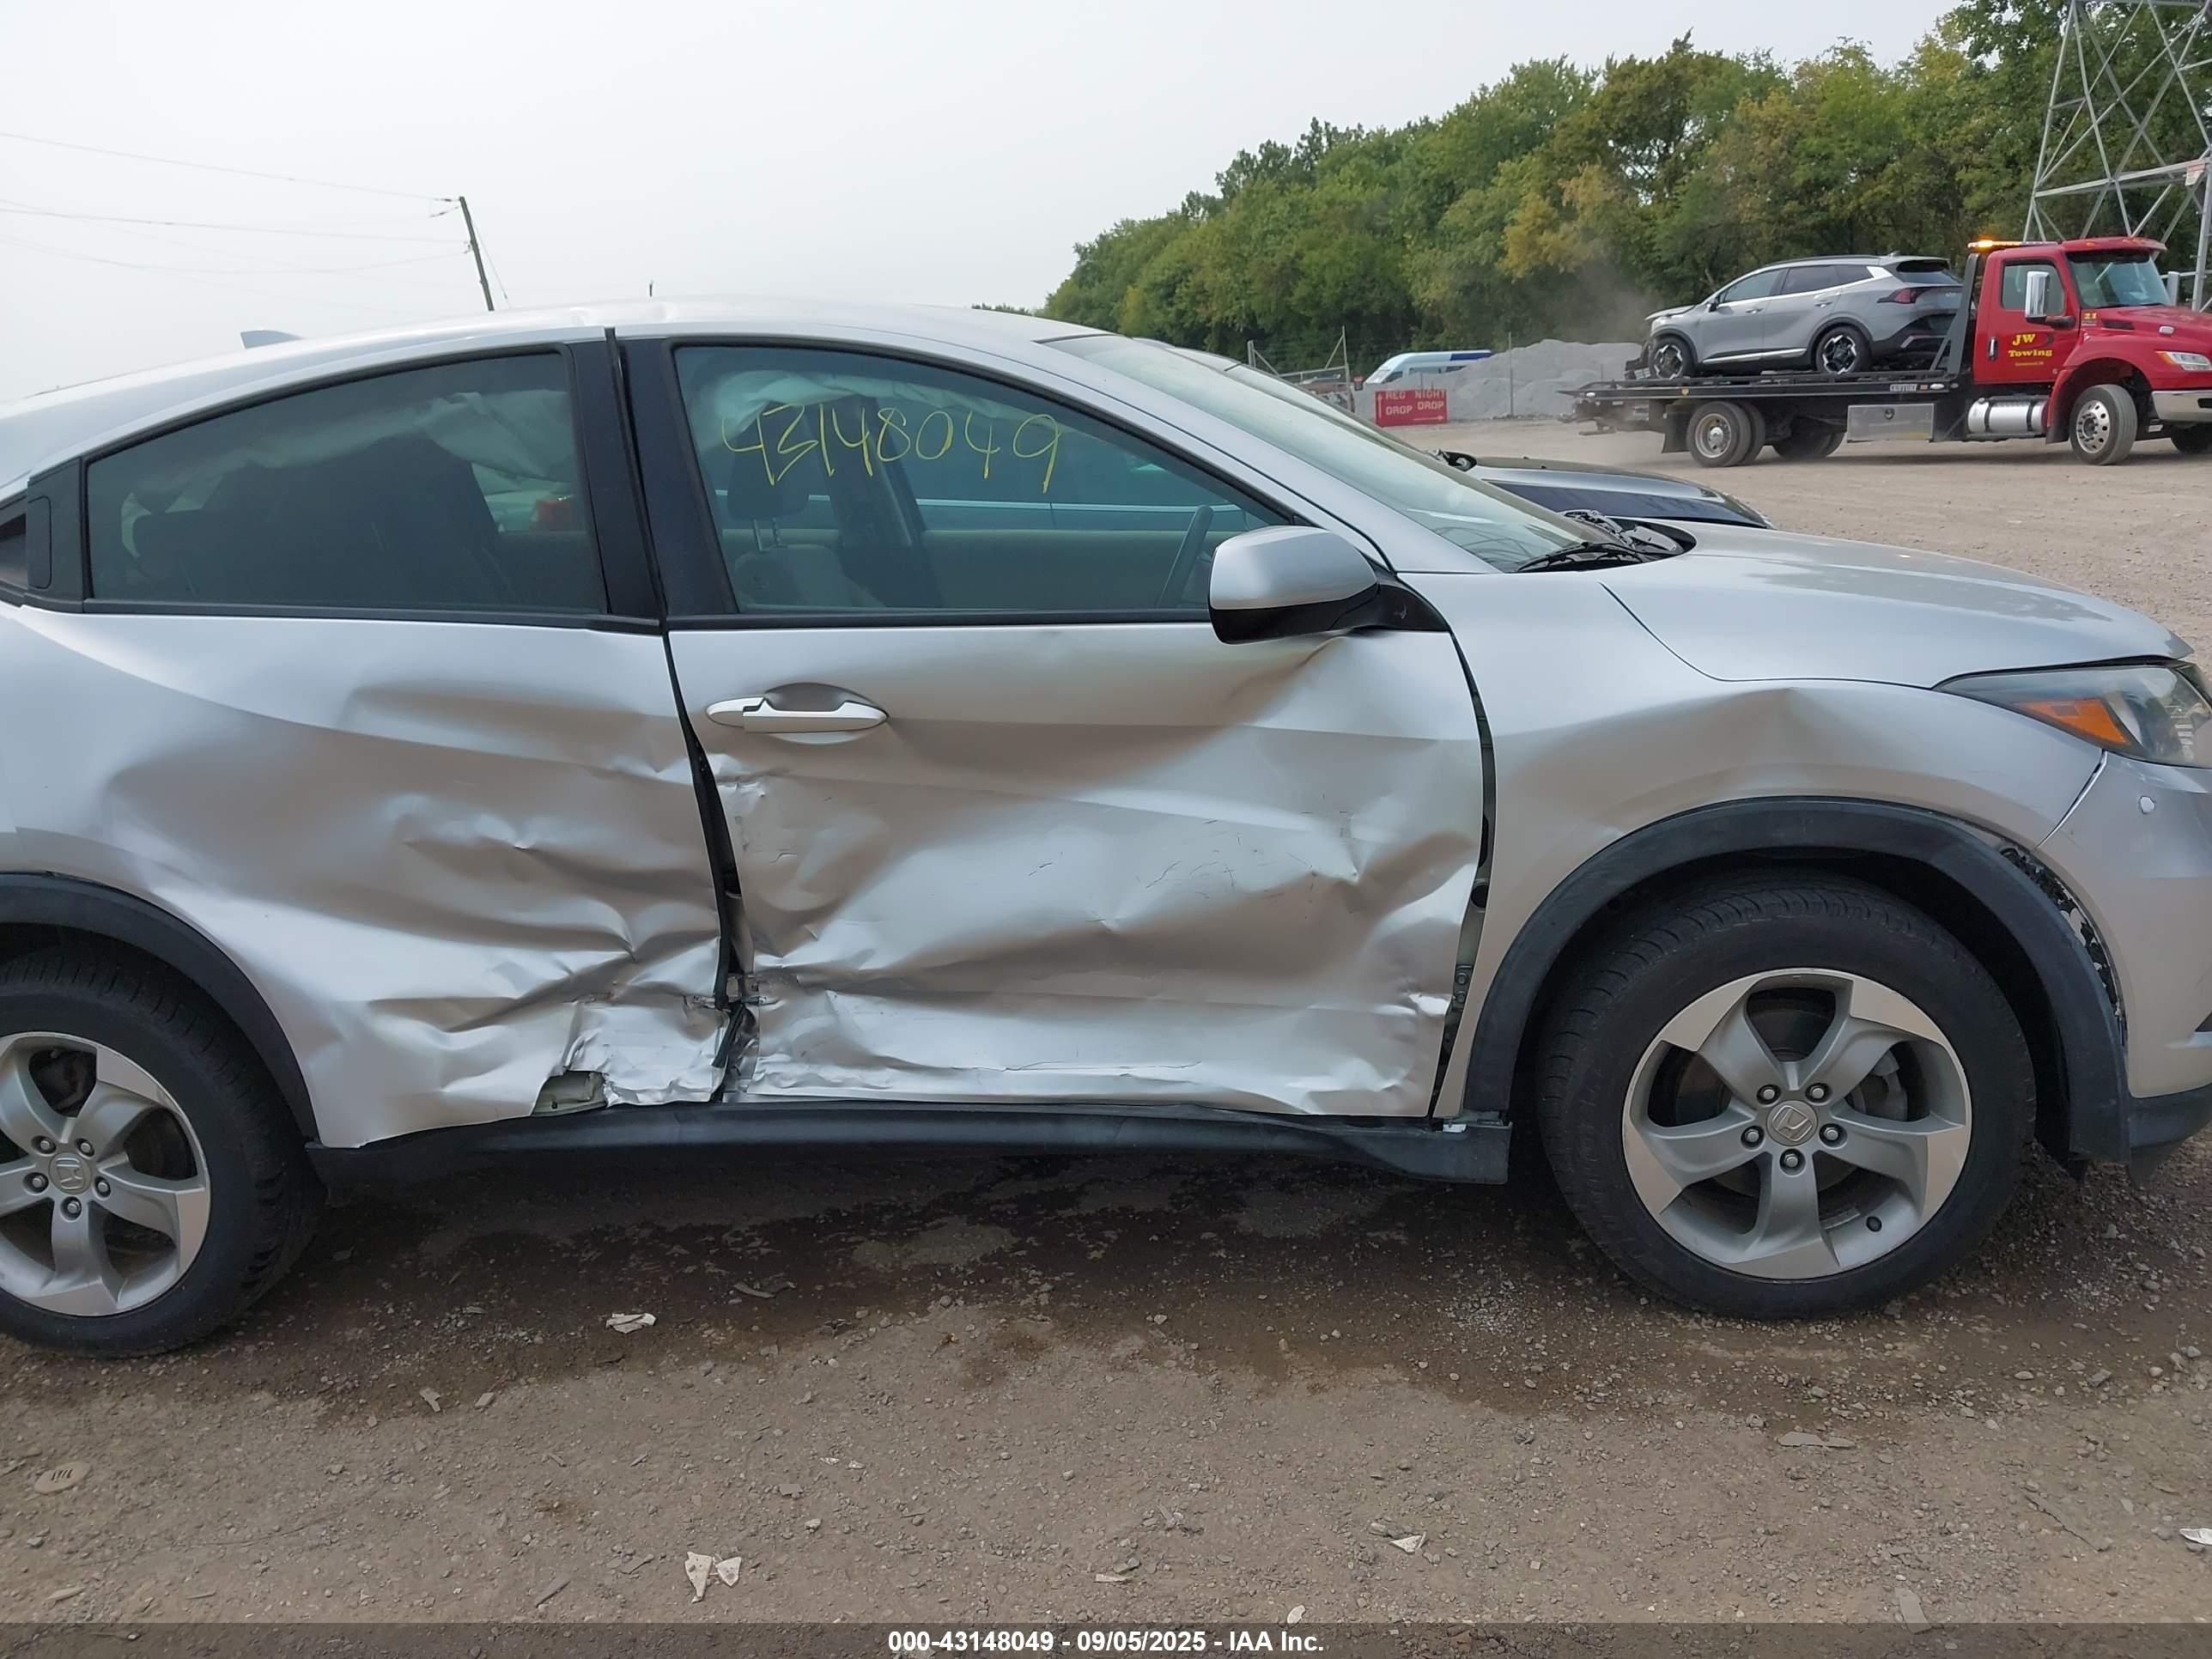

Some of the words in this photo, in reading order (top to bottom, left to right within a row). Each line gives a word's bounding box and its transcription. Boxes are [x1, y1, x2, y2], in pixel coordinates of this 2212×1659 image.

[2012, 333, 2036, 346] JW
[2008, 349, 2053, 357] Towing
[1385, 405, 1413, 416] DROP
[1417, 401, 1444, 410] DROP
[722, 403, 1062, 494] 43148049
